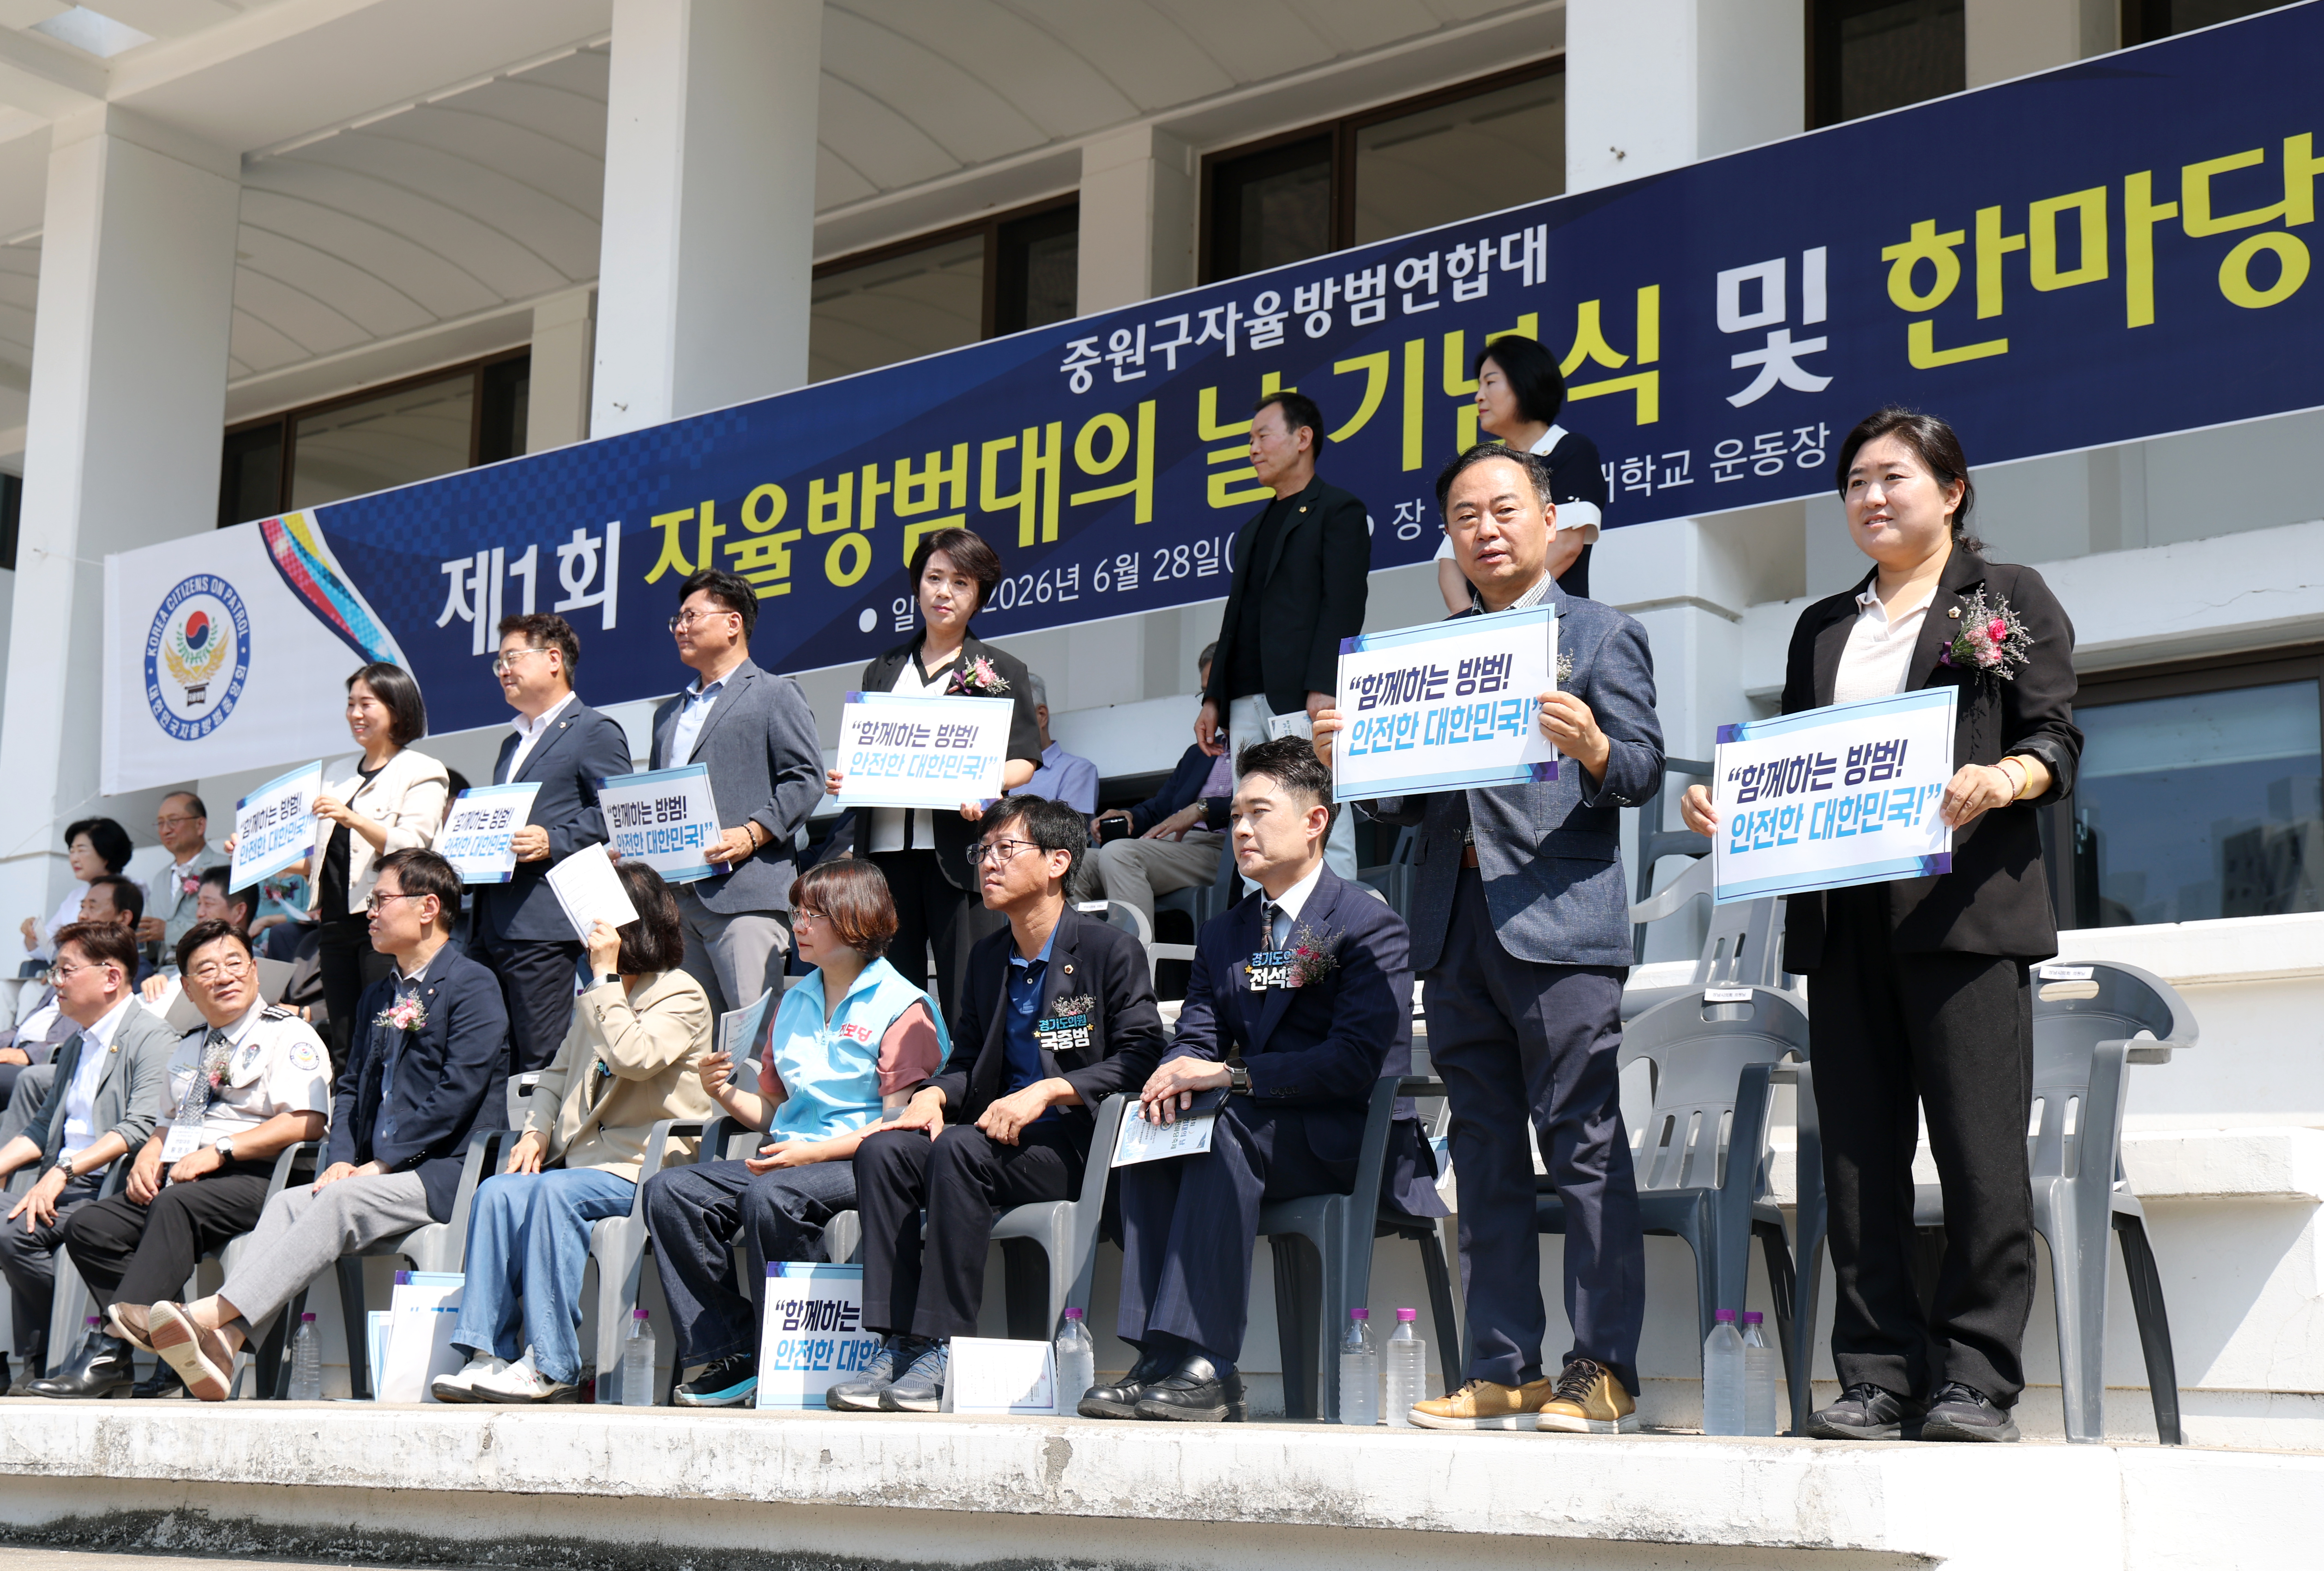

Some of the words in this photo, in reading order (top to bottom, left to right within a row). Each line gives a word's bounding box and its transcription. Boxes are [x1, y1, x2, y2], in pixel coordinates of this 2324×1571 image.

[1060, 224, 1547, 394] 중원구자율방범연합대
[435, 520, 620, 656] 제1회
[644, 399, 1156, 599] 자율방범대의
[1717, 246, 1834, 408] 및
[1881, 132, 2324, 370] 한마당
[1392, 498, 1426, 540] 장
[1710, 422, 1830, 483] 운동장
[982, 563, 1079, 613] 2026년
[1094, 552, 1138, 593] 6월
[147, 610, 169, 656] KOREA
[166, 577, 208, 611] CITIZENS
[210, 578, 225, 597] ON
[223, 589, 248, 639] PATROL
[1349, 664, 1449, 711] “함께하는
[1456, 653, 1513, 696] 방범!
[148, 665, 247, 739] 대한민국자율방범중앙회
[852, 720, 931, 748] “함께하는
[934, 724, 979, 748] 방범!
[1348, 711, 1419, 756] 안전한
[849, 752, 905, 777] 안전한
[907, 754, 998, 780] 대한민국!”
[1728, 752, 1837, 804] “함께하는
[1844, 739, 1908, 786] 방범!
[241, 806, 277, 840] “함께하는
[281, 792, 302, 820] 방범!
[489, 807, 515, 829] 방범!
[607, 801, 652, 828] “함께하는
[656, 796, 686, 823] 방범!
[1729, 803, 1804, 854] 안전한
[1808, 783, 1942, 840] 대한민국!”
[240, 834, 265, 866] 안전한
[442, 836, 472, 858] 안전한
[616, 832, 644, 857] 안전한
[646, 822, 712, 854] 대한민국!”
[1252, 950, 1298, 967] 경기도의
[1039, 1014, 1087, 1032] 경기도의원
[1041, 1027, 1090, 1050] 국중범
[1170, 1120, 1181, 1149] 한마당축제
[775, 1299, 860, 1332] “함께하는
[774, 1339, 834, 1371] 안전한
